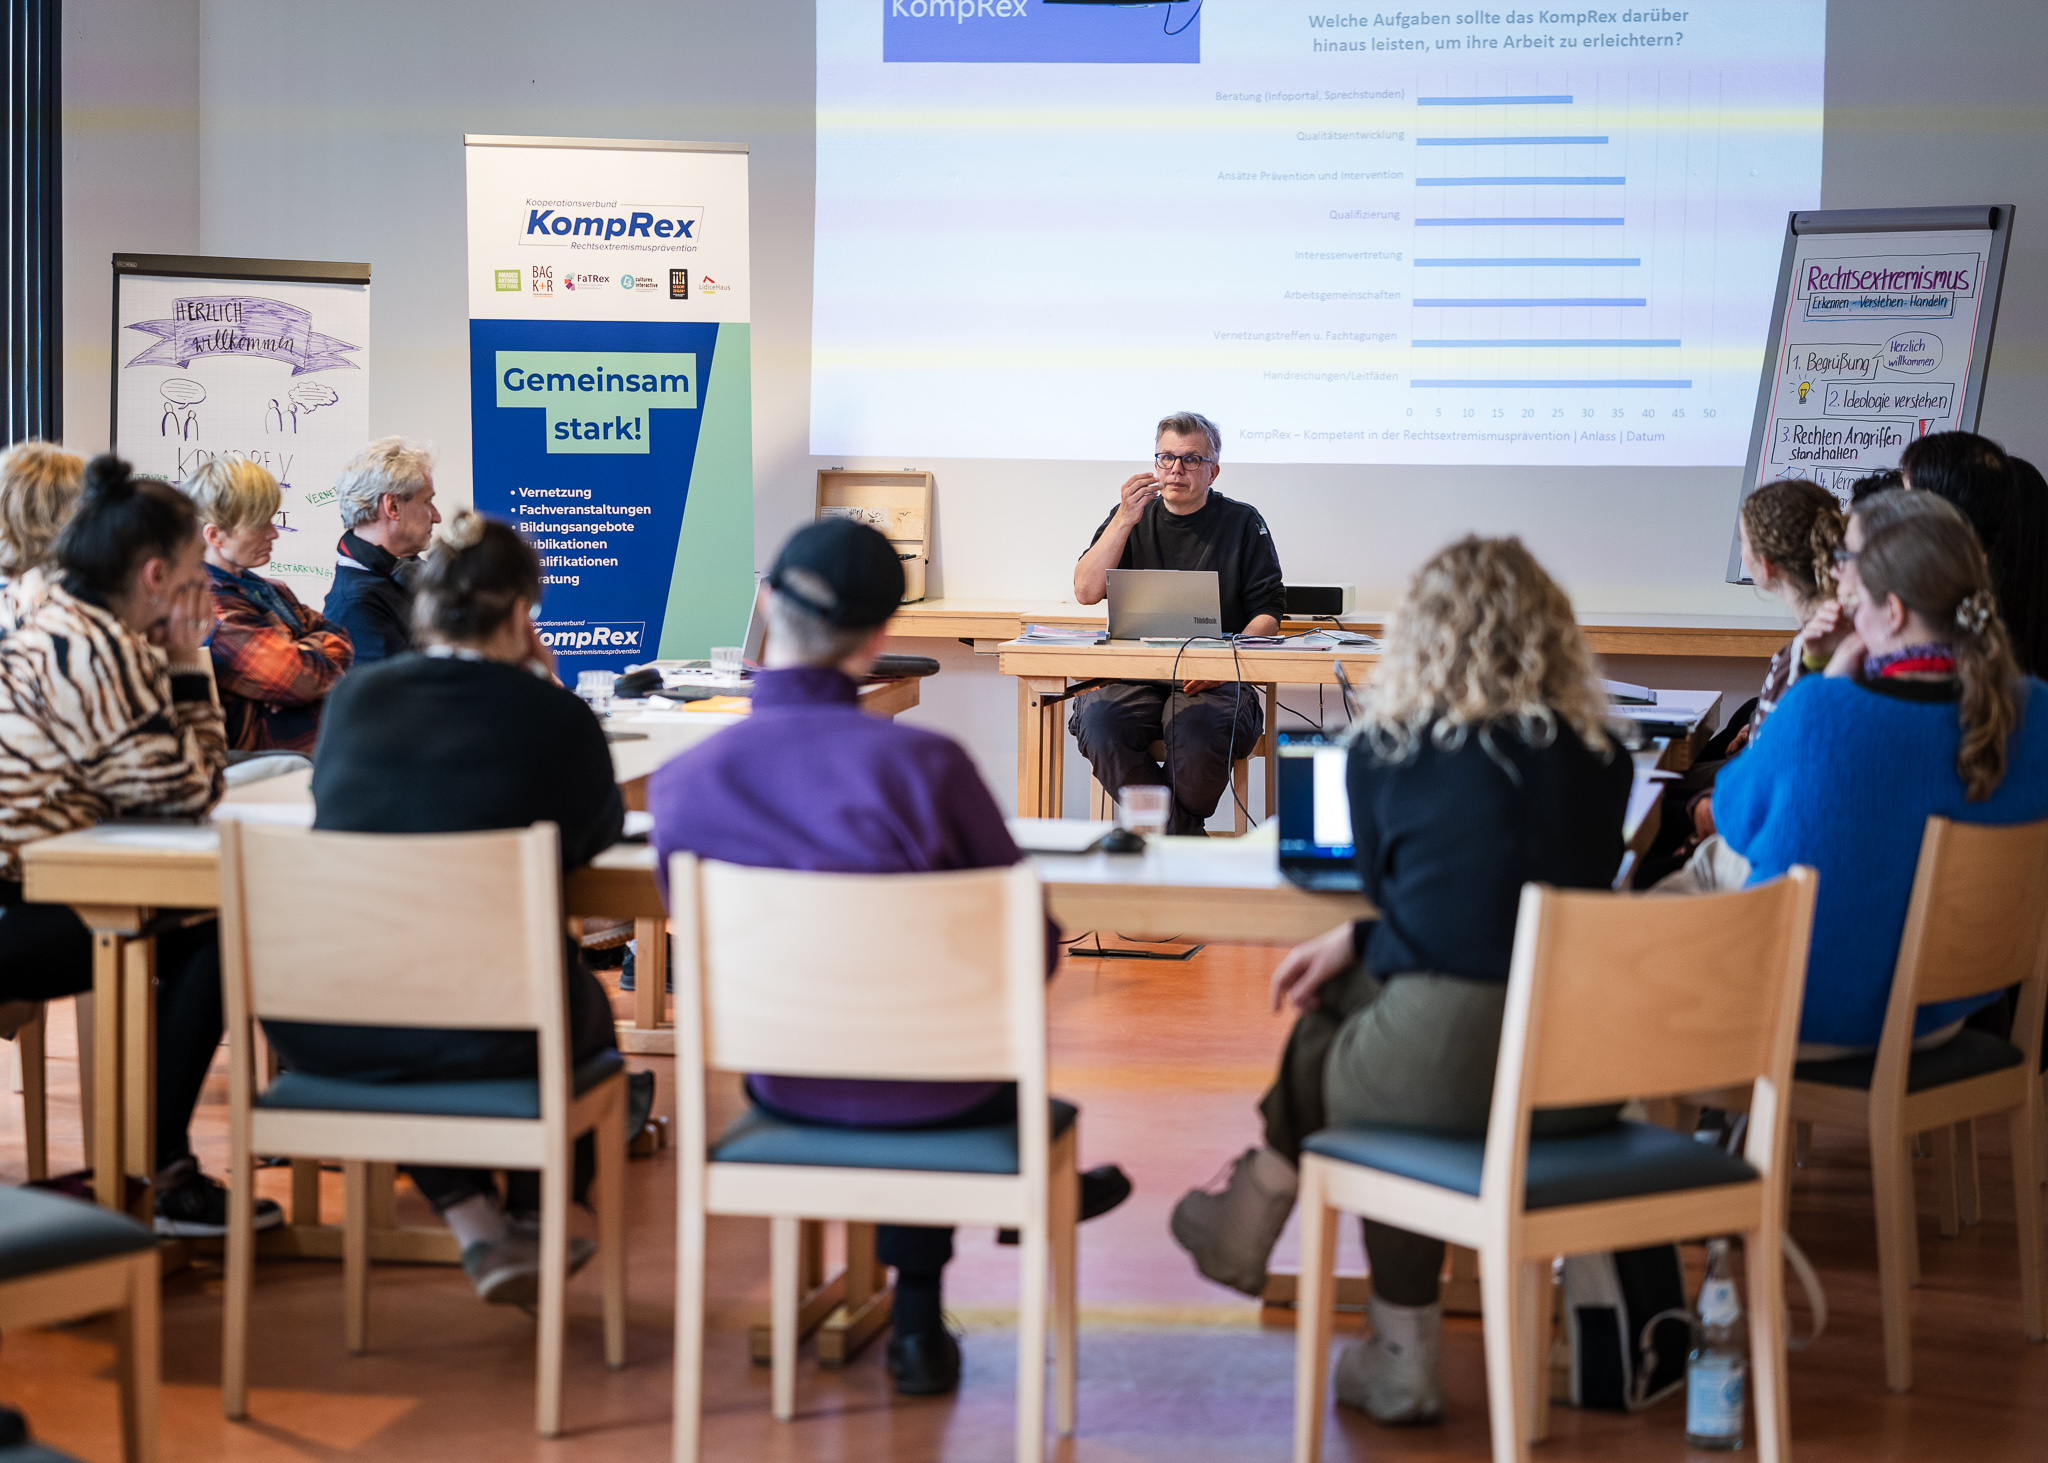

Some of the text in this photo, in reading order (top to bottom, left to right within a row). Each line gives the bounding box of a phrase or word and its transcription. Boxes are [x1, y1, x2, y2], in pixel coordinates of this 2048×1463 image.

[892, 0, 1028, 24] KompRex
[1309, 9, 1689, 29] Welche Aufgaben sollte das KompRex darüber
[1313, 32, 1683, 54] hinaus leisten, um ihre Arbeit zu erleichtern?
[1216, 89, 1404, 102] Beratung (Infoportal, Sprechstunden)
[1297, 130, 1404, 141] Qualitätsentwicklung
[1218, 170, 1403, 180] Ansätze Prävention und Intervention
[526, 198, 617, 208] Kooperationsverbund
[1329, 210, 1400, 221] Qualifizierung
[527, 210, 695, 240] KompRex
[570, 242, 697, 252] Rechtsextremismusprävention
[1295, 251, 1402, 261] Interessenvertretung
[532, 266, 552, 278] BAG
[1807, 265, 1969, 291] Rechtsextremismus
[578, 274, 609, 283] FaTRex
[532, 280, 553, 292] K+R
[1284, 290, 1401, 301] Arbeitsgemeinschaften
[1812, 296, 1849, 309] Erkennen
[1860, 295, 1903, 308] Verstehen
[1910, 294, 1948, 308] Handeln
[176, 302, 242, 323] HERZLICH
[1214, 331, 1310, 342] Vernetzungstreffen
[1326, 331, 1397, 342] Fachtagungen
[193, 330, 295, 356] willkommen
[1890, 340, 1925, 352] Herzlich
[1792, 352, 1870, 377] 1. Begrüßung
[1888, 356, 1934, 367] willkommen
[504, 366, 689, 392] Gemeinsam
[1264, 371, 1398, 382] Handreichungen/Leitfäden
[1829, 388, 1947, 413] 2. Ideologie verstehen
[1406, 408, 1716, 418] 0 5 10 15 20 25 30 35 40 45 50
[554, 416, 641, 440] stark!
[1240, 429, 1291, 442] KompRex
[1304, 430, 1364, 442] Kompetent
[1368, 430, 1378, 439] in
[1382, 430, 1400, 440] der
[1404, 430, 1570, 443] Rechtsextremismusprävention
[1580, 430, 1616, 442] Anlass
[1627, 431, 1665, 442] Datum
[1780, 424, 1902, 449] 3. Rechten Angriffen
[1789, 446, 1858, 460] standhalten
[519, 488, 592, 499] Vernetzung
[520, 504, 651, 516] Fachveranstaltungen
[520, 522, 634, 534] Bildungsangebote
[527, 538, 607, 549] ublikationen
[539, 556, 618, 566] alifikationen
[270, 562, 333, 579] BESTÄRKUNG
